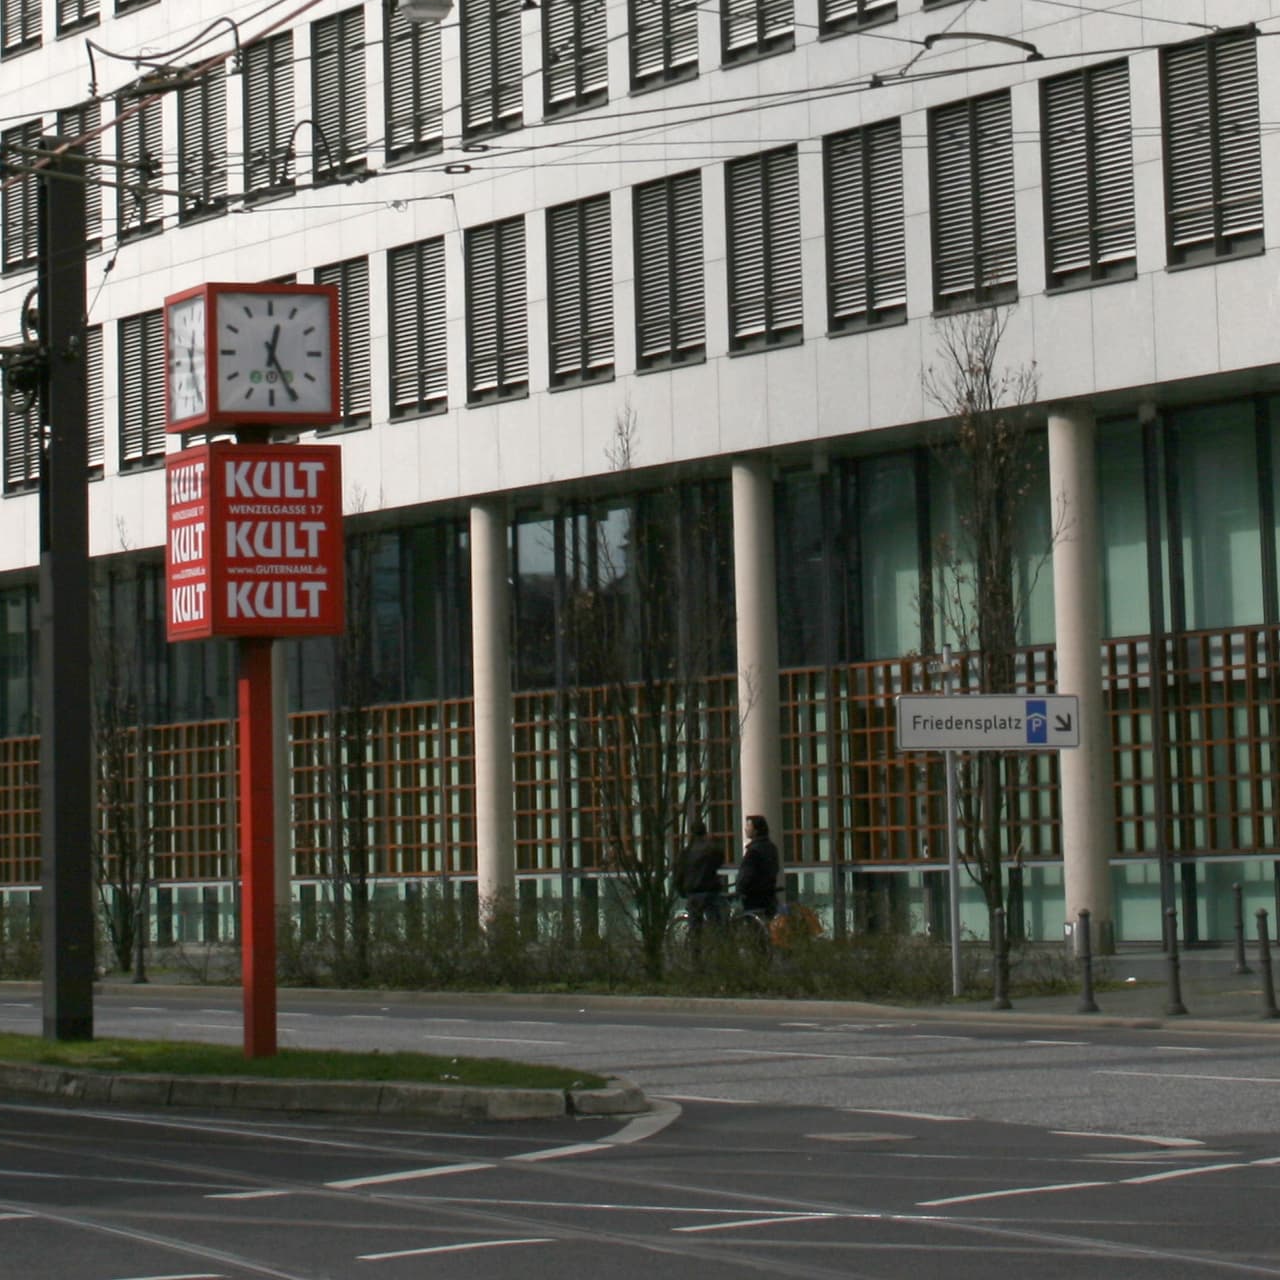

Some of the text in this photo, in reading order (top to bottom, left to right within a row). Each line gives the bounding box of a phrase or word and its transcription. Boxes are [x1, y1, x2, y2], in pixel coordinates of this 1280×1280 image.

[171, 463, 204, 505] KULT
[225, 461, 326, 498] KULT
[229, 505, 323, 515] WENZELGASSE 17
[172, 522, 205, 565] KULT
[226, 521, 326, 558] KULT
[172, 583, 206, 624] KULT
[227, 582, 328, 618] KULT
[912, 715, 1023, 734] Friedensplatz
